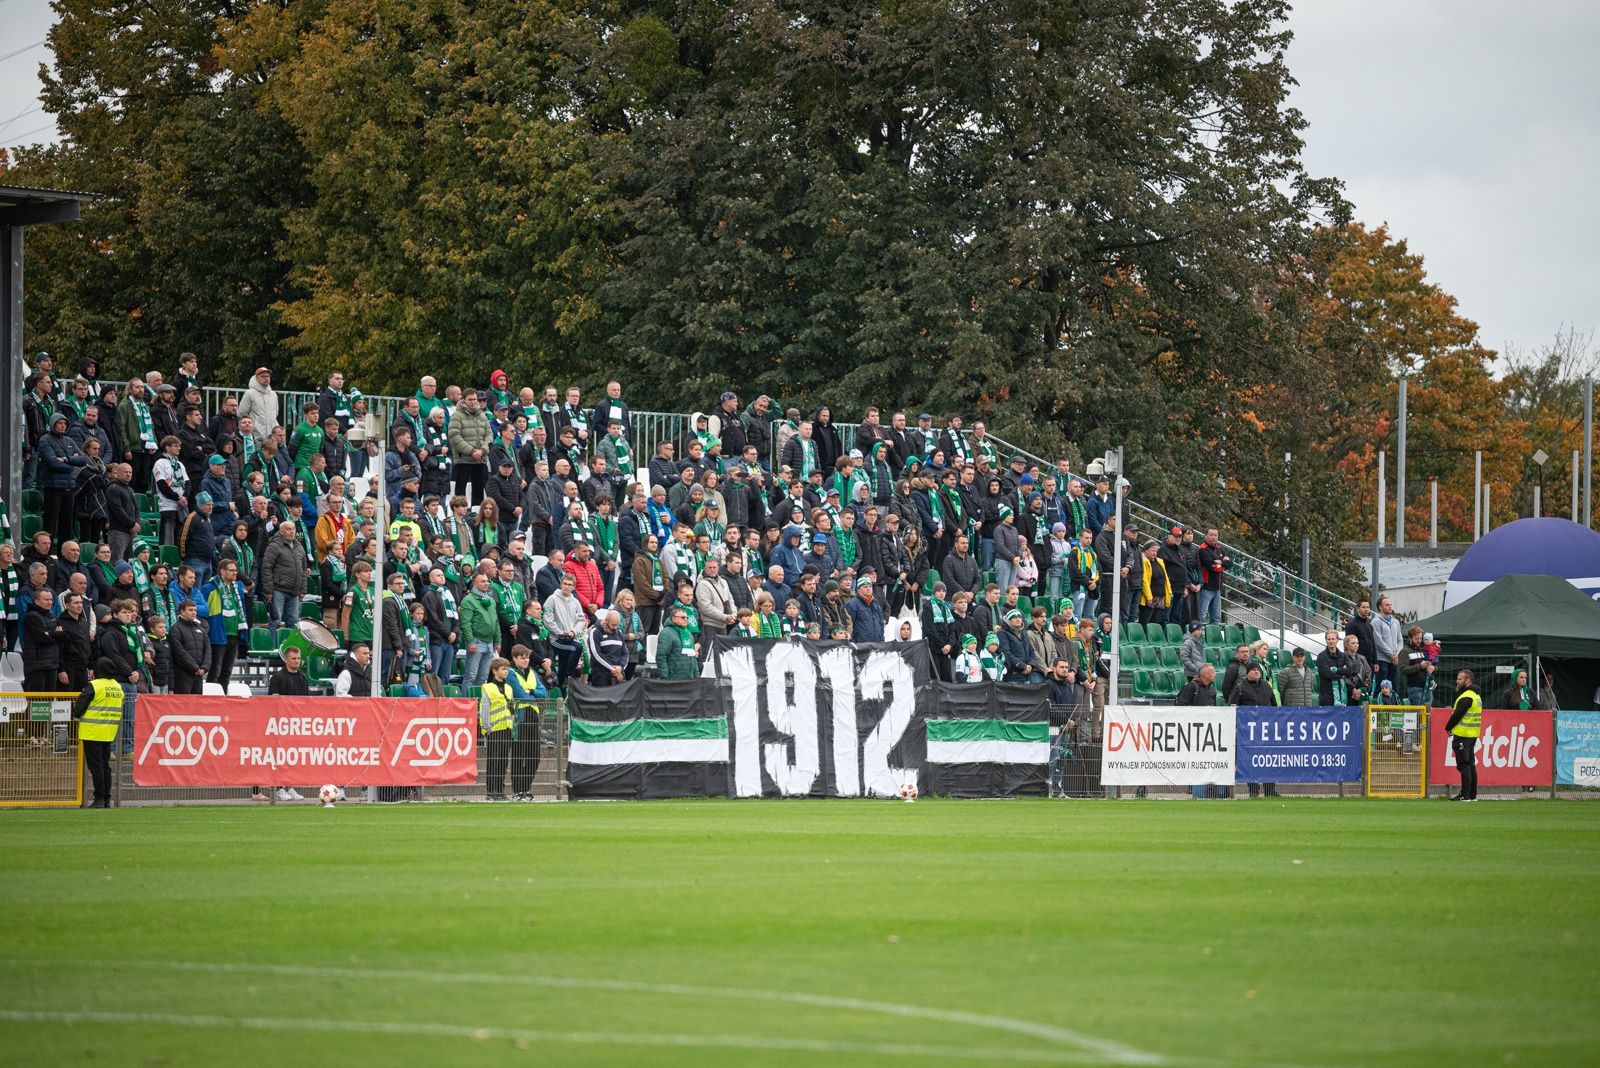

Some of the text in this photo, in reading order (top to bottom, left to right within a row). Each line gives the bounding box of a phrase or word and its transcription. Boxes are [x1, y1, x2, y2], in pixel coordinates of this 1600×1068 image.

[2, 706, 8, 717] 8
[719, 641, 920, 797] 1912
[1371, 716, 1376, 725] 9
[265, 717, 358, 736] AGREGATY
[1247, 721, 1351, 741] TELESKOP
[1107, 721, 1228, 752] DANRENTAL
[240, 743, 380, 770] PRĄDOTWÓRCZE
[1108, 761, 1140, 770] WYNAJEM
[1140, 759, 1186, 770] PODNOŚNIKÓW
[1190, 760, 1229, 770] RUSZTOWAŃ
[1251, 754, 1346, 767] CODZIENNIE O 18:30
